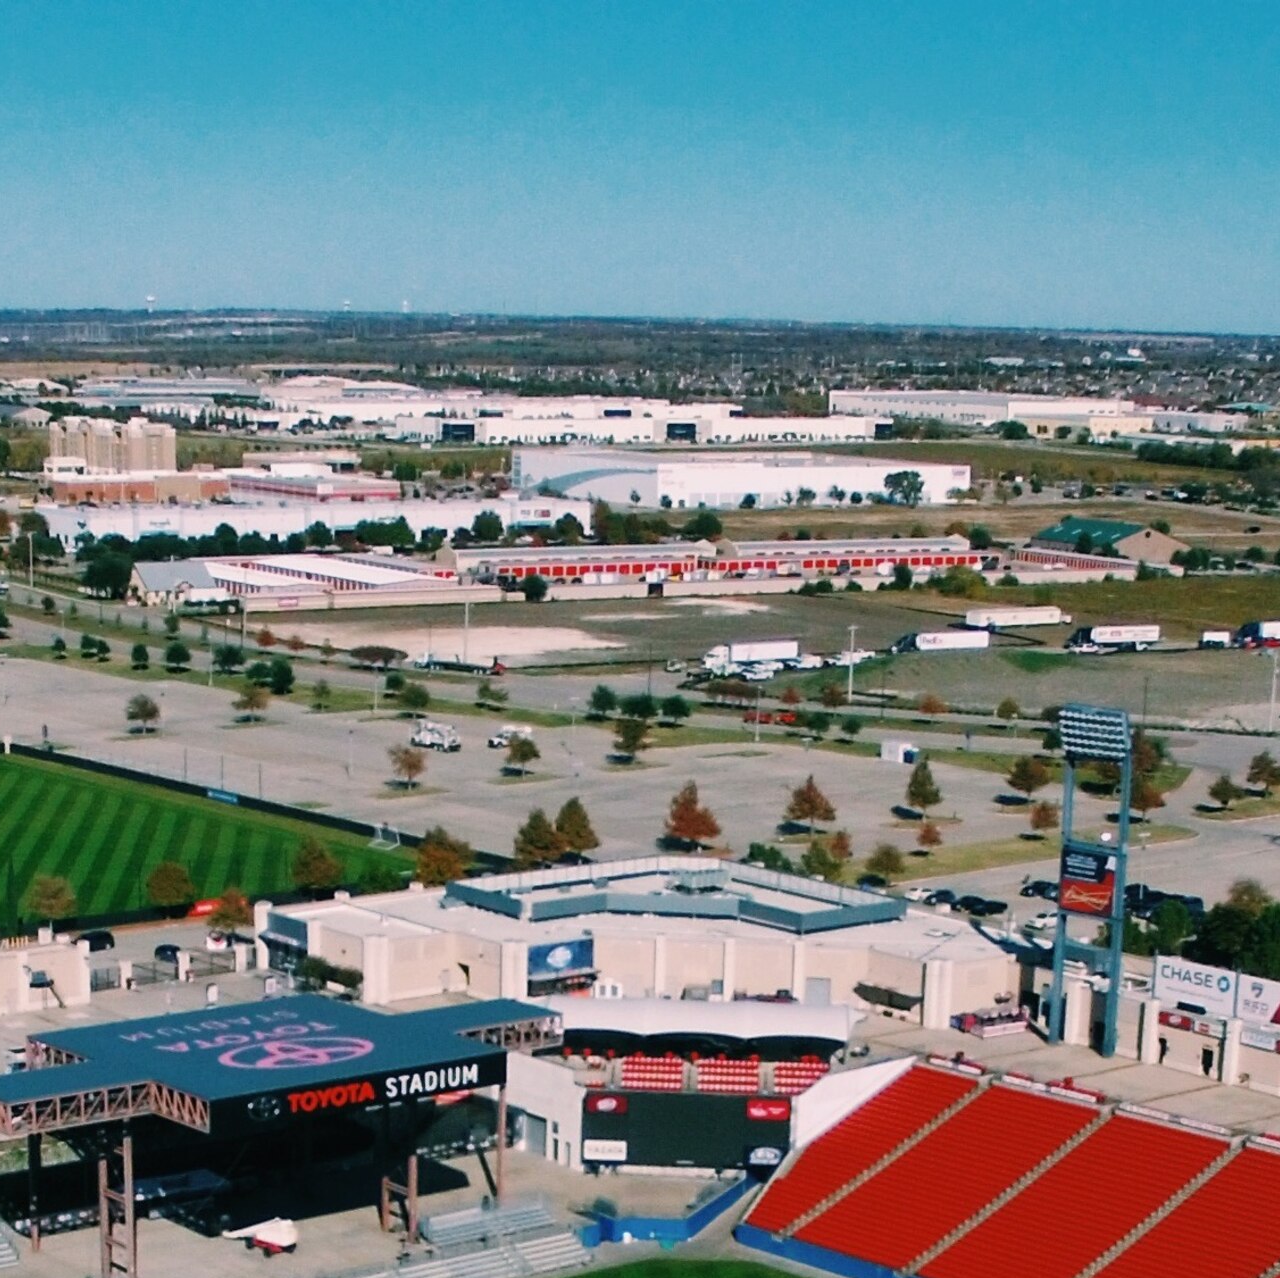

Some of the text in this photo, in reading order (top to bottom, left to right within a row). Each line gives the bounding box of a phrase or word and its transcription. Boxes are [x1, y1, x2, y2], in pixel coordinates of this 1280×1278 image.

[1160, 964, 1214, 989] CHASE
[287, 1063, 479, 1114] TOYOTA STADIUM
